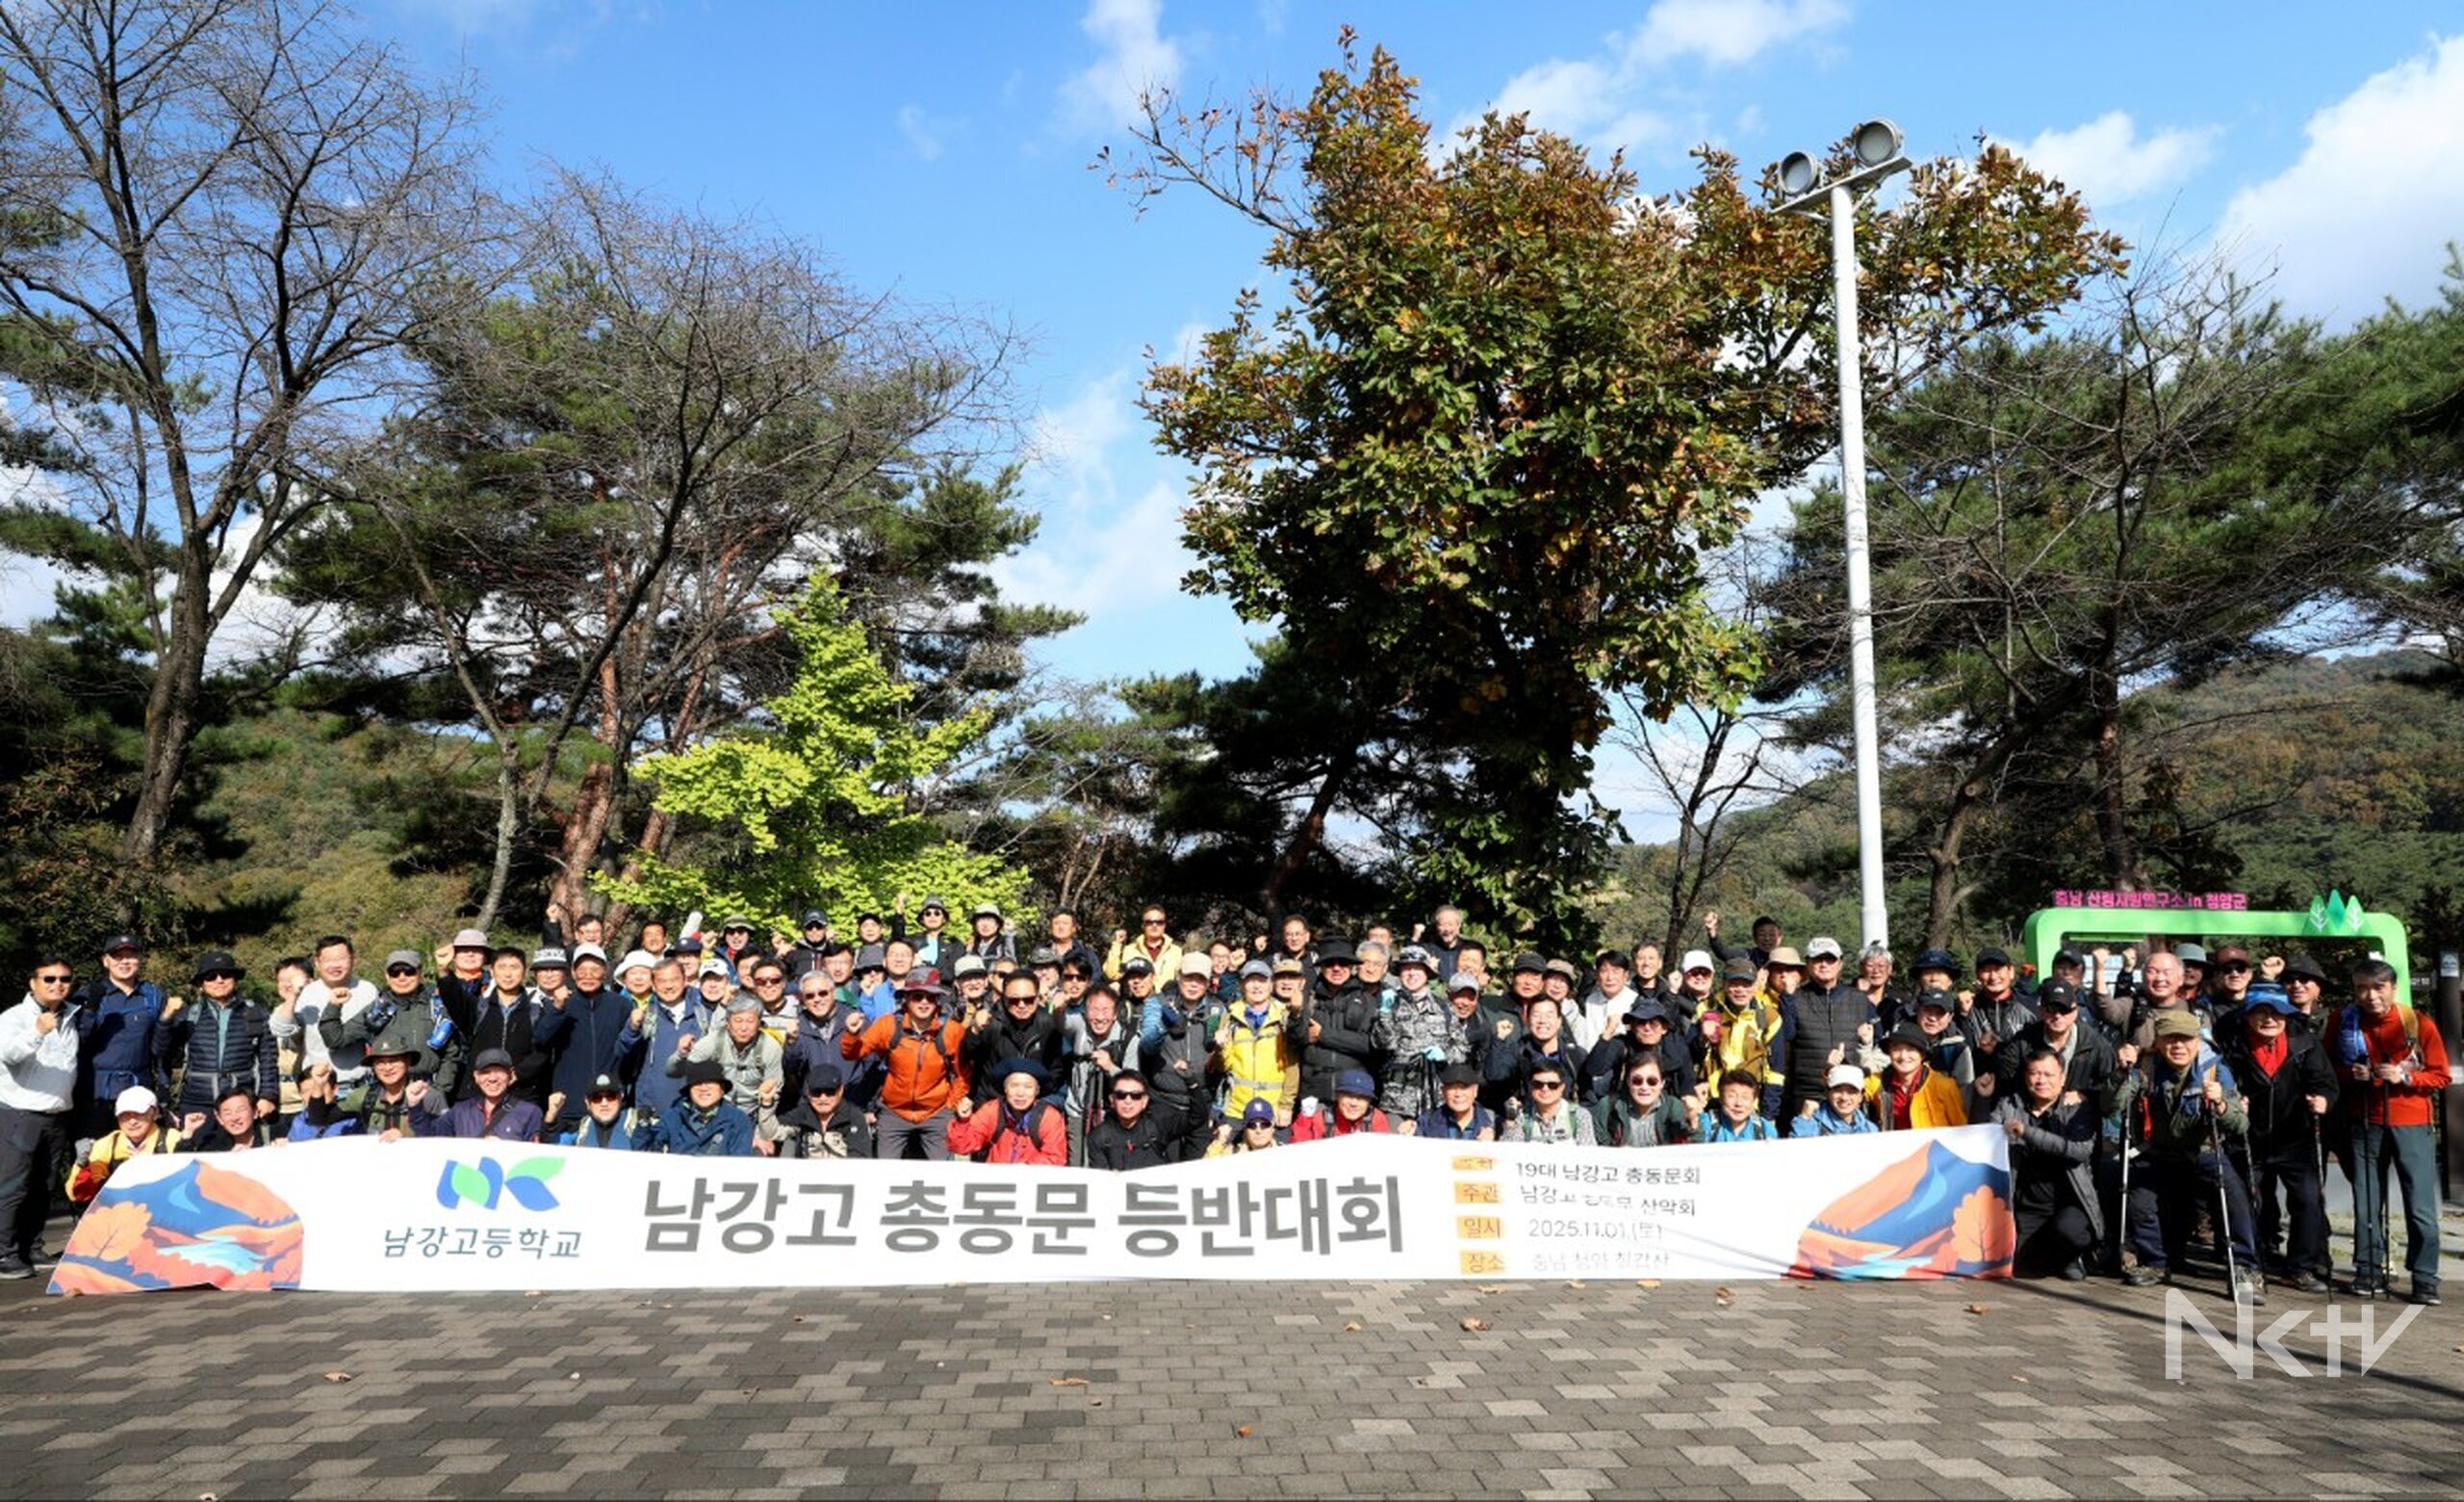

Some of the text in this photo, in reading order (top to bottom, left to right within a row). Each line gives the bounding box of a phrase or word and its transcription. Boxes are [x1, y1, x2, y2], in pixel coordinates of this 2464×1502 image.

[1516, 1162, 1556, 1178] 19대
[1563, 1164, 1618, 1183] 남강고
[1626, 1167, 1700, 1184] 총동문회
[1463, 1183, 1499, 1203] 주관
[1641, 1199, 1695, 1216] 산악회
[644, 1177, 1403, 1256] 남강고 총동문 등반대회
[1464, 1217, 1501, 1239] 일시
[385, 1227, 581, 1259] 남강고등학교
[1469, 1253, 1505, 1273] 장소
